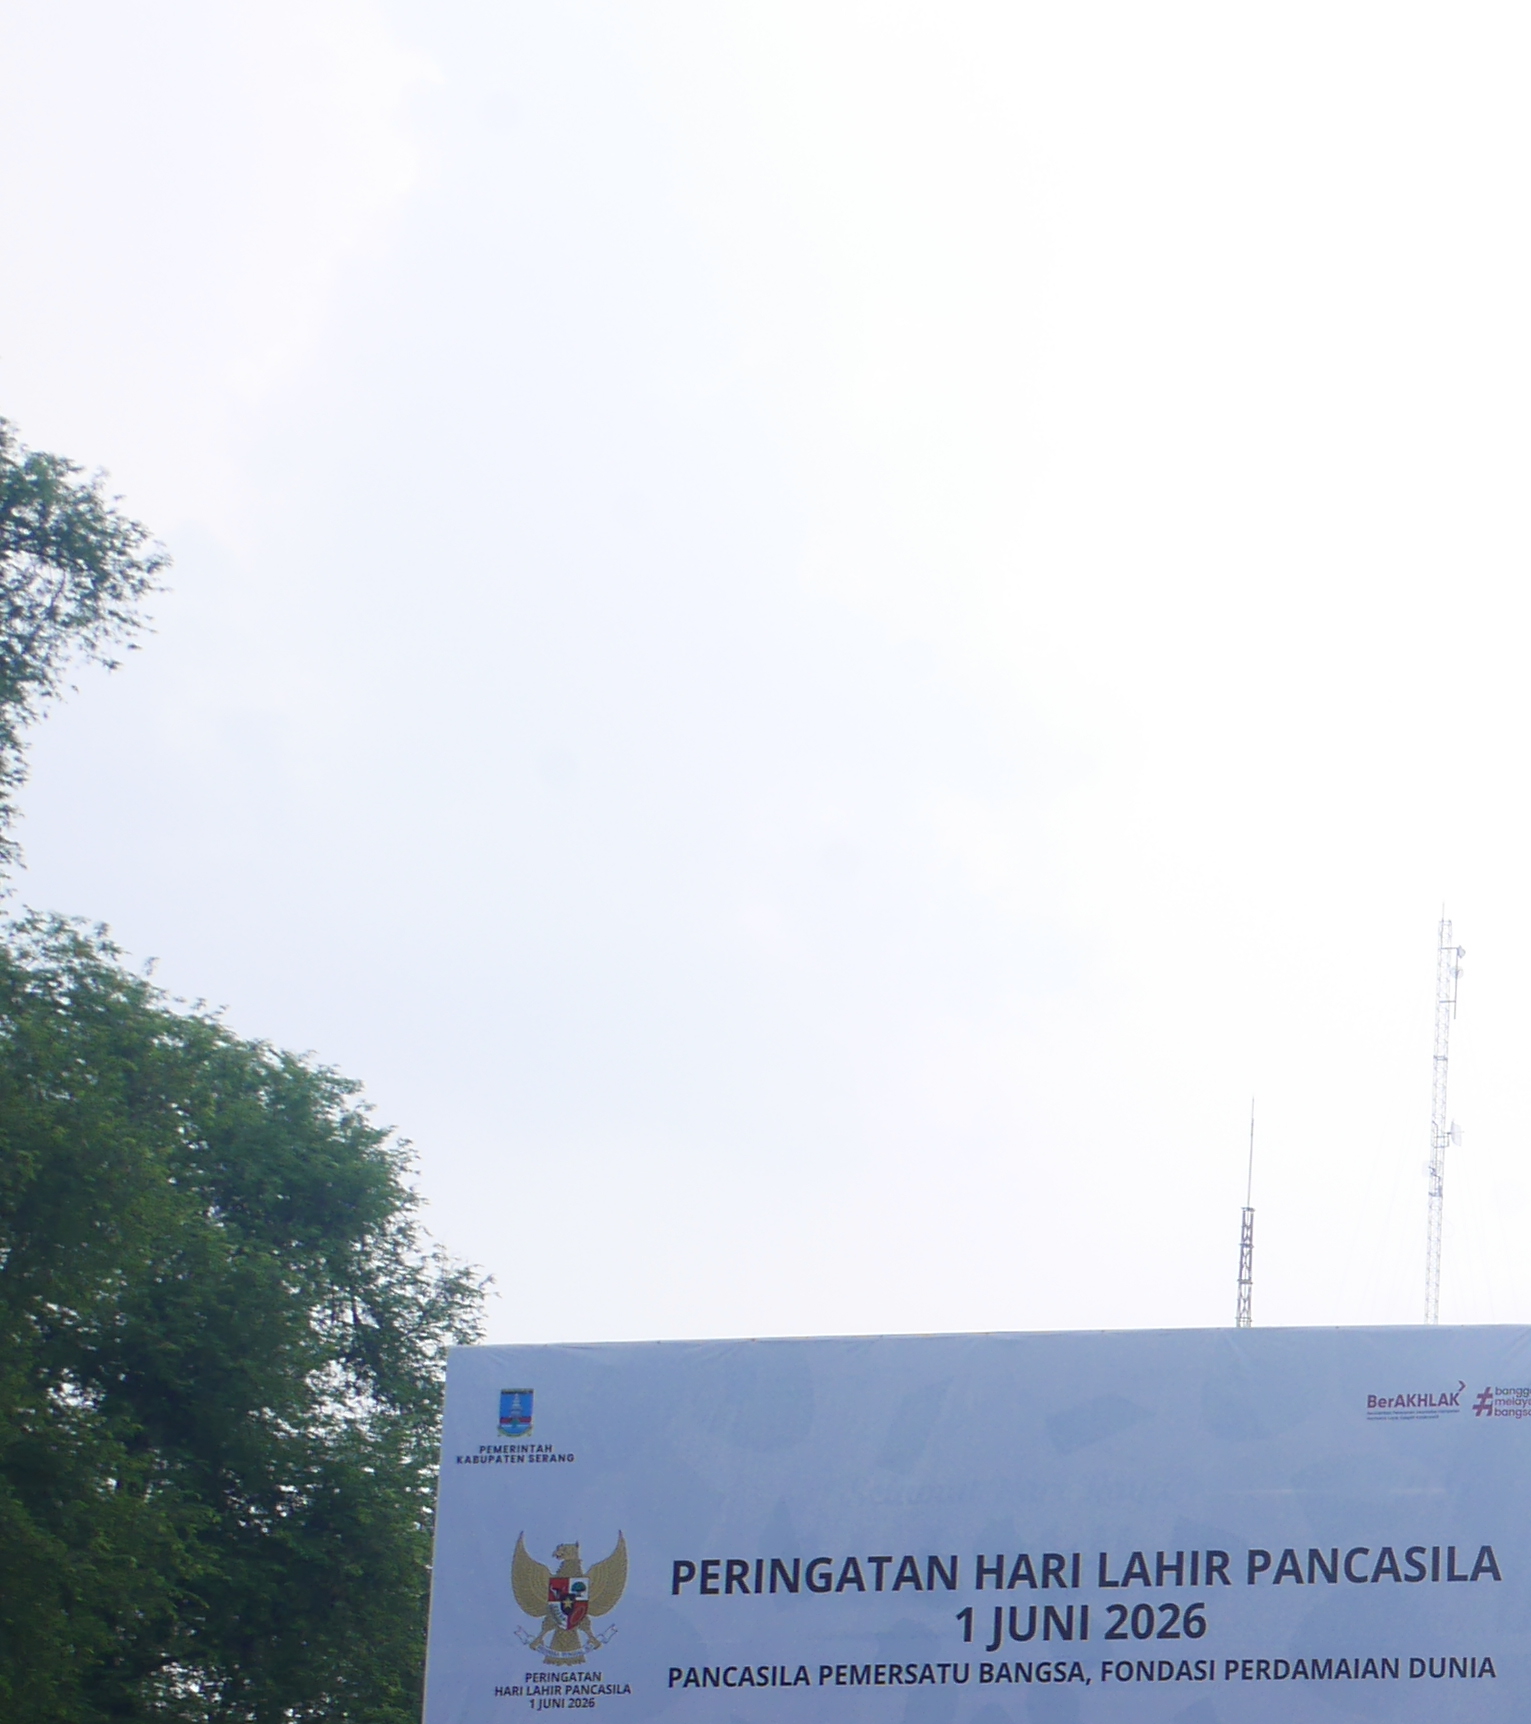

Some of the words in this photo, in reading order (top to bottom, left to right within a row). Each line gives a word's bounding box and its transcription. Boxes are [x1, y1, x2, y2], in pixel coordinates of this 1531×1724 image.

[1367, 1393, 1460, 1408] BerAKHLAK
[478, 1444, 553, 1455] PEMERINTAH
[456, 1454, 525, 1465] KABUPATEN
[528, 1453, 575, 1464] SERANG
[671, 1555, 959, 1595] PERINGATAN
[975, 1551, 1080, 1591] HARI
[1098, 1549, 1231, 1589] LAHIR
[1247, 1545, 1502, 1586] PANCASILA
[956, 1607, 974, 1643] 1
[985, 1603, 1090, 1651] JUNI
[1103, 1601, 1208, 1641] 2026
[525, 1671, 602, 1683] PERINGATAN
[668, 1664, 811, 1688] PANCASILA
[818, 1662, 971, 1687] PEMERSATU
[979, 1660, 1091, 1687] BANGSA,
[1100, 1658, 1215, 1683] FONDASI
[1224, 1656, 1400, 1682] PERDAMAIAN
[1409, 1655, 1497, 1680] DUNIA
[494, 1685, 523, 1697] HARI
[526, 1684, 562, 1697] LAHIR
[565, 1683, 632, 1696] PANCASILA
[529, 1698, 535, 1709] 1
[537, 1697, 565, 1711] JUNI
[568, 1697, 595, 1709] 2026
